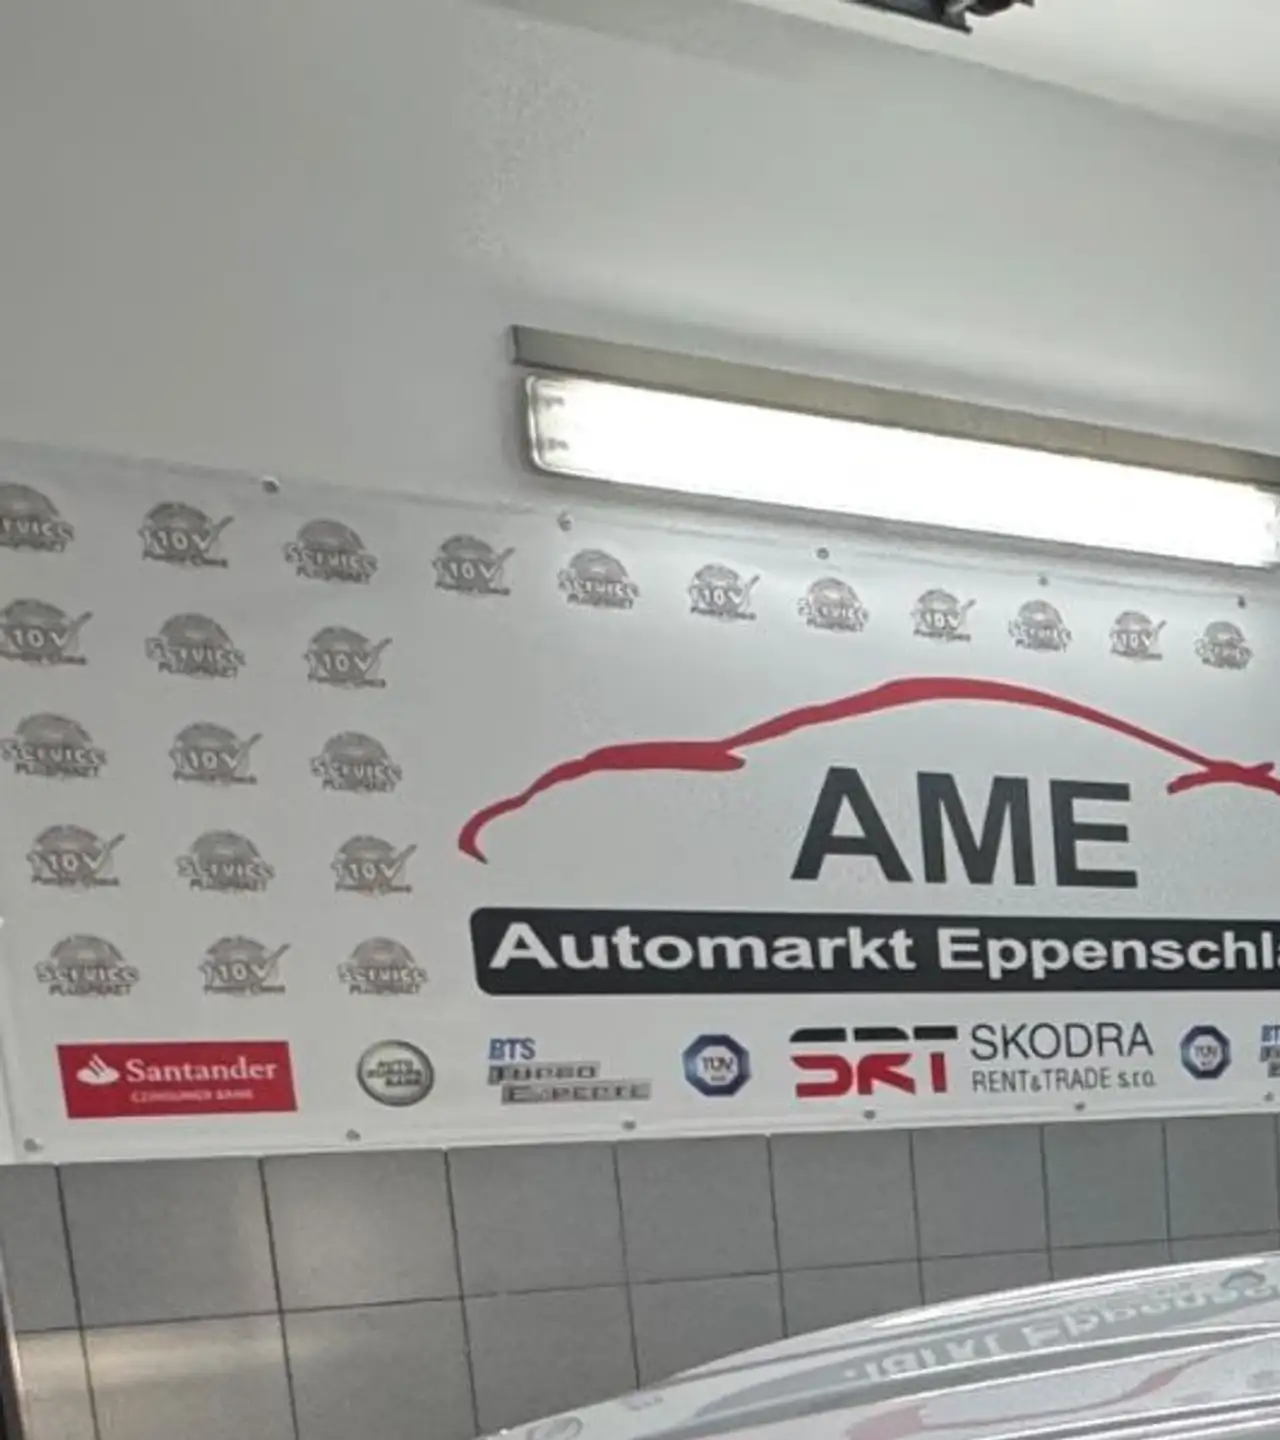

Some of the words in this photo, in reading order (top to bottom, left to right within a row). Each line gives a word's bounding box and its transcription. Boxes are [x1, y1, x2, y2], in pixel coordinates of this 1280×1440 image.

[791, 767, 1138, 889] AME
[490, 920, 915, 970] Automarkt
[489, 1038, 536, 1060] BTS
[970, 1022, 1154, 1061] SKODRA
[126, 1055, 277, 1082] Santander
